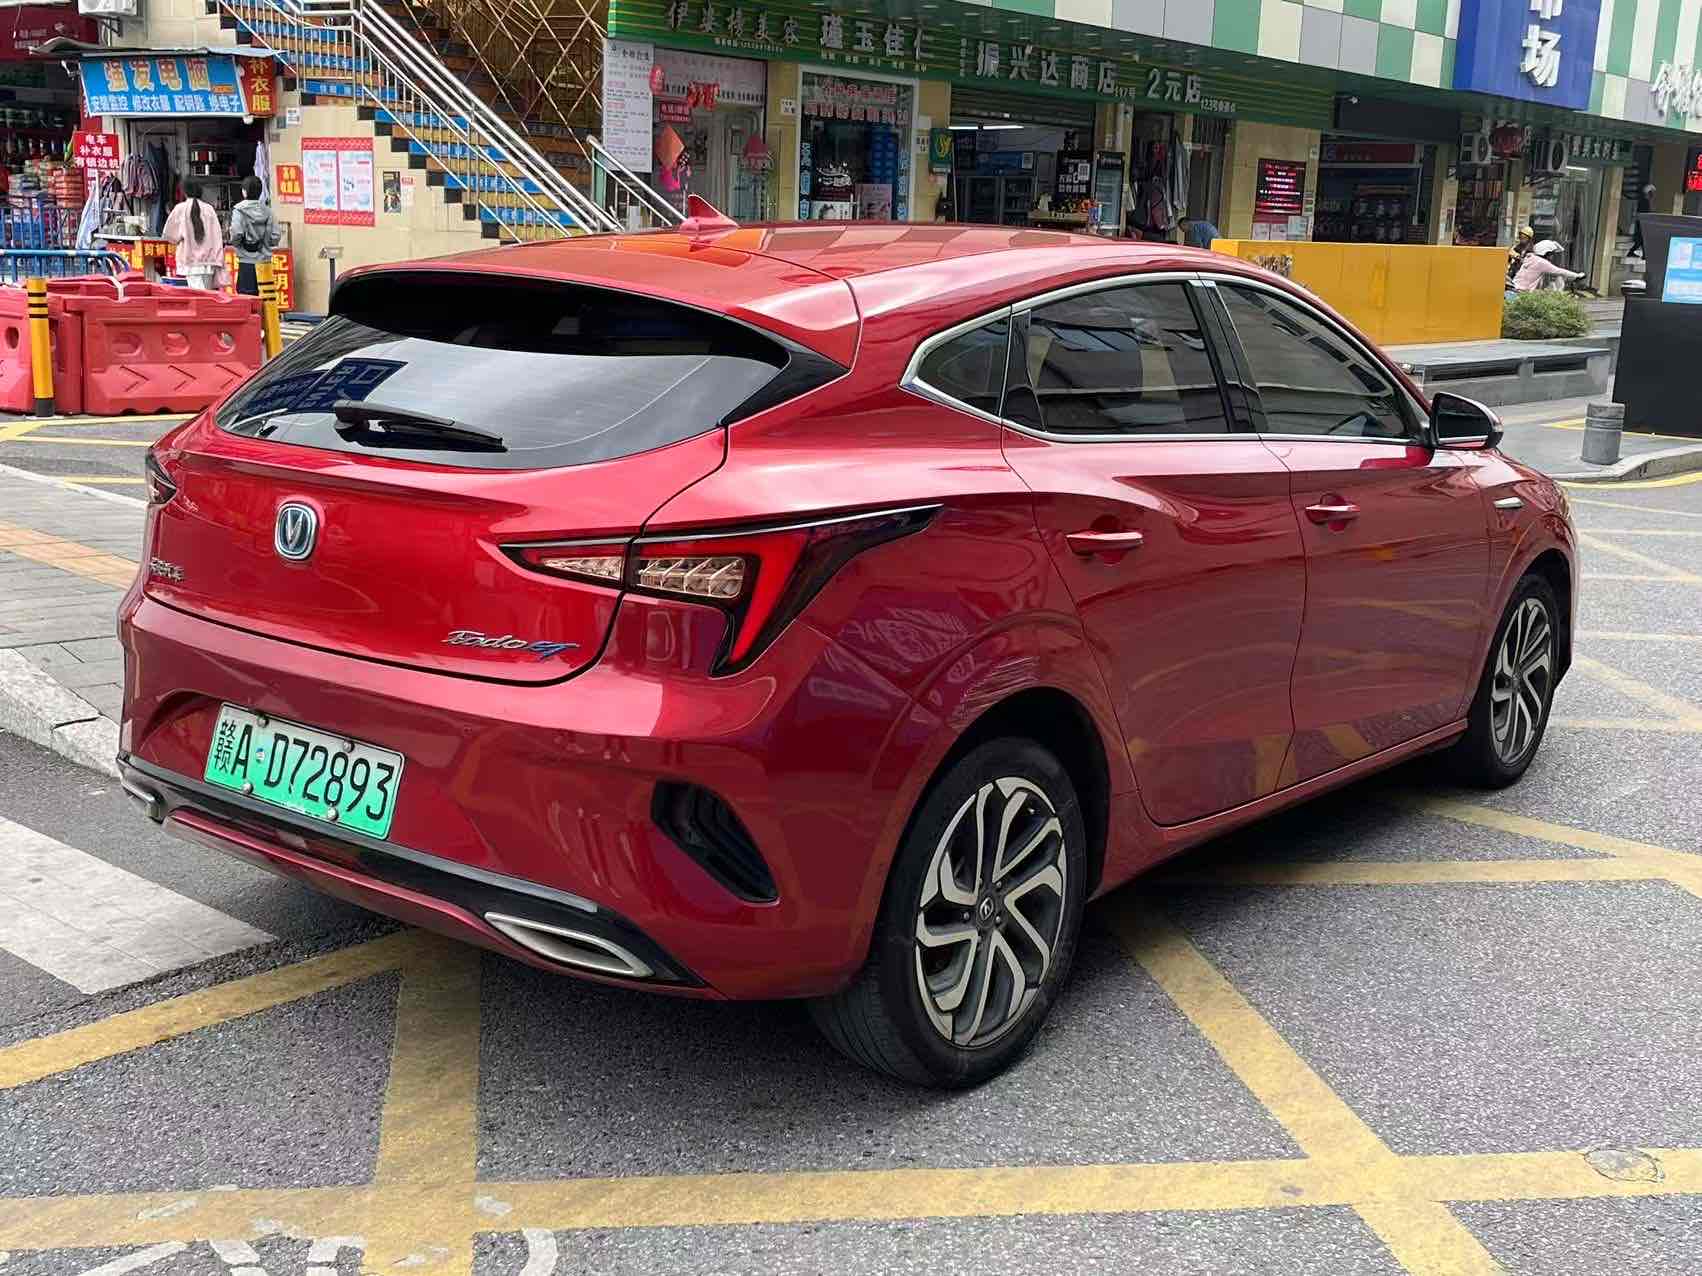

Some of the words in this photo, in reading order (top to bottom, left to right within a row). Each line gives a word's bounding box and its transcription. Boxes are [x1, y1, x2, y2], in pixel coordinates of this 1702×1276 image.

[249, 59, 272, 112] 补衣服
[976, 43, 1119, 95] 振兴达商店
[1146, 67, 1201, 103] 2元店
[79, 145, 113, 157] 补衣服
